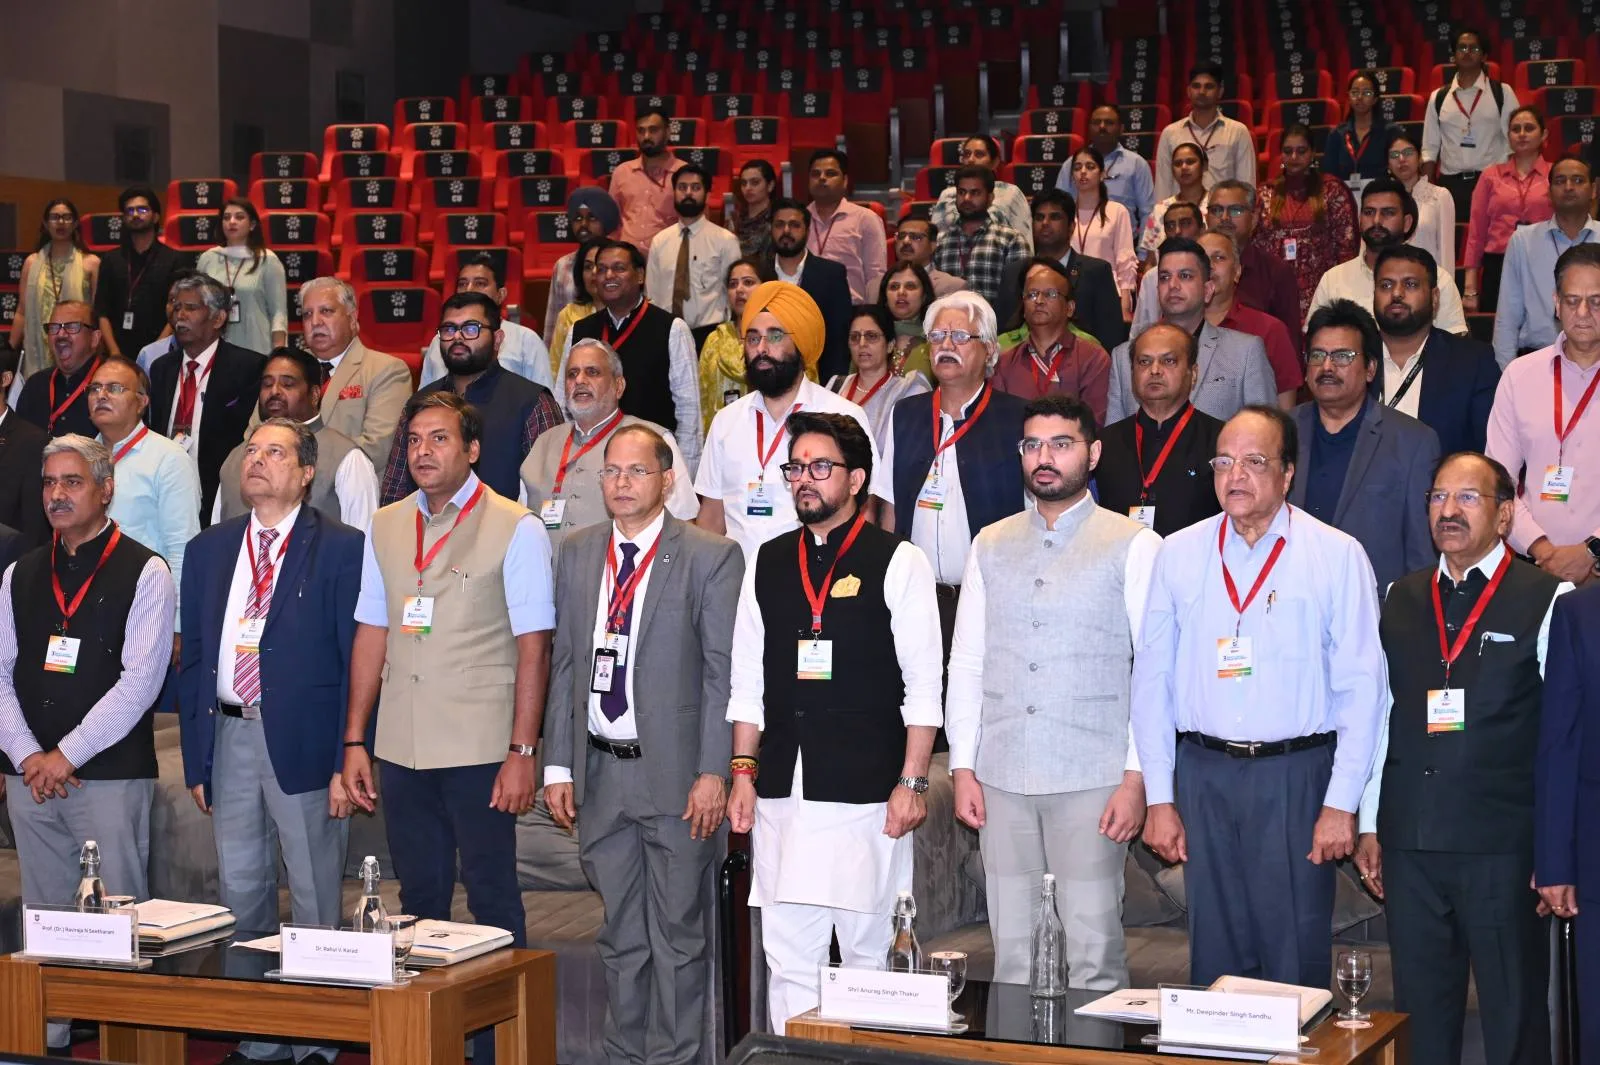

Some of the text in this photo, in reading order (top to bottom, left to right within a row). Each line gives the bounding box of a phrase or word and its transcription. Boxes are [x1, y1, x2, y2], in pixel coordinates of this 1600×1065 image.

[1545, 77, 1557, 85] CU
[1564, 104, 1576, 112] CU
[1047, 125, 1057, 133] CU
[1131, 122, 1141, 130] CU
[752, 132, 762, 140] CU
[1581, 135, 1593, 144] CU
[430, 139, 441, 147] CU
[510, 138, 521, 146] CU
[1042, 152, 1054, 161] CU
[441, 167, 452, 175] CU
[524, 166, 535, 174] CU
[1032, 182, 1043, 191] CU
[280, 197, 291, 205] CU
[367, 195, 379, 203] CU
[539, 194, 550, 202] CU
[110, 232, 120, 240] CU
[197, 232, 208, 240] CU
[288, 231, 299, 240] CU
[374, 231, 385, 240] CU
[465, 231, 477, 240] CU
[556, 230, 568, 238] CU
[289, 269, 300, 278] CU
[384, 267, 396, 276] CU
[3, 311, 15, 320] CU
[393, 307, 405, 317] CU
[65, 927, 83, 935] Raviraja
[859, 987, 881, 996] Anurag
[882, 989, 898, 997] Singh
[898, 990, 920, 998] Thakur
[1196, 1008, 1228, 1018] Deepinder
[1229, 1011, 1248, 1019] Singh
[1248, 1012, 1272, 1020] Sandhu
